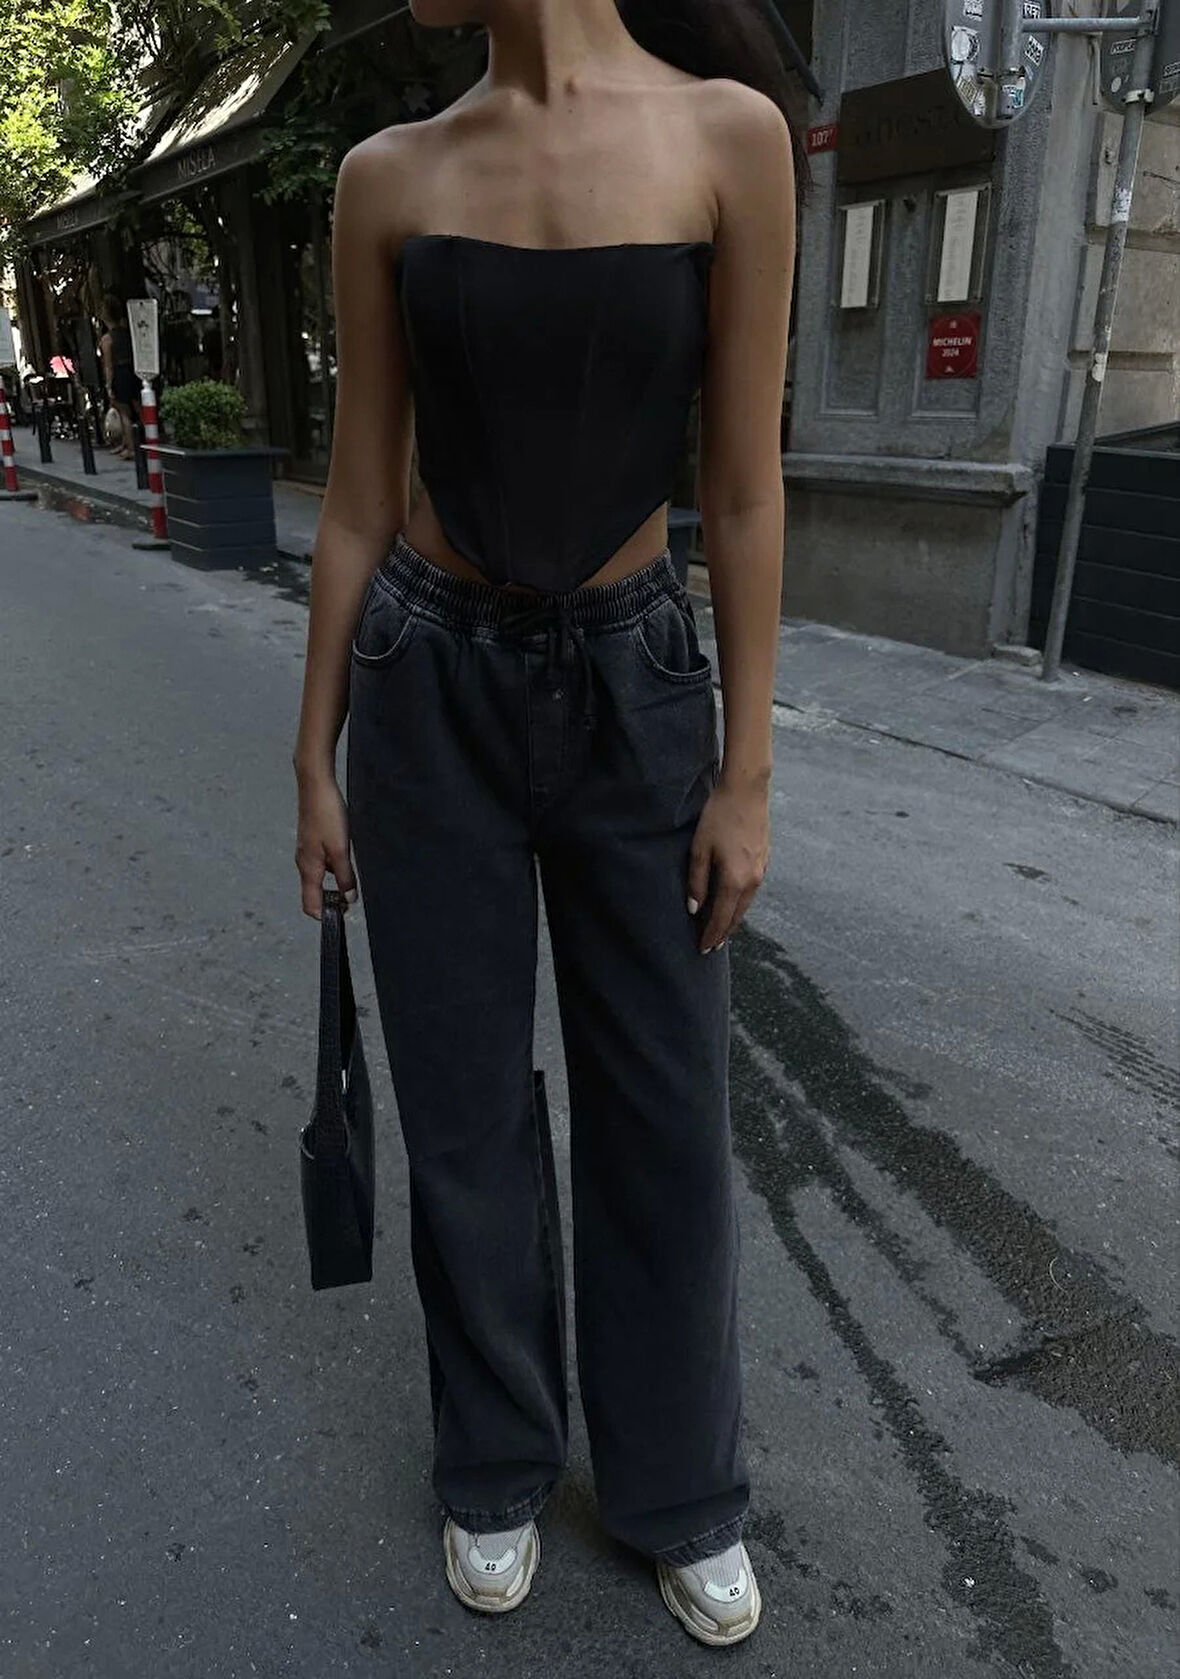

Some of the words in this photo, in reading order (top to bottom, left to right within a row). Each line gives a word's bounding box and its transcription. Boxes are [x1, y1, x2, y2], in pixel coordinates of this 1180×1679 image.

[932, 336, 972, 347] MICHELIN
[484, 1562, 497, 1571] 40
[729, 1587, 740, 1597] 40
